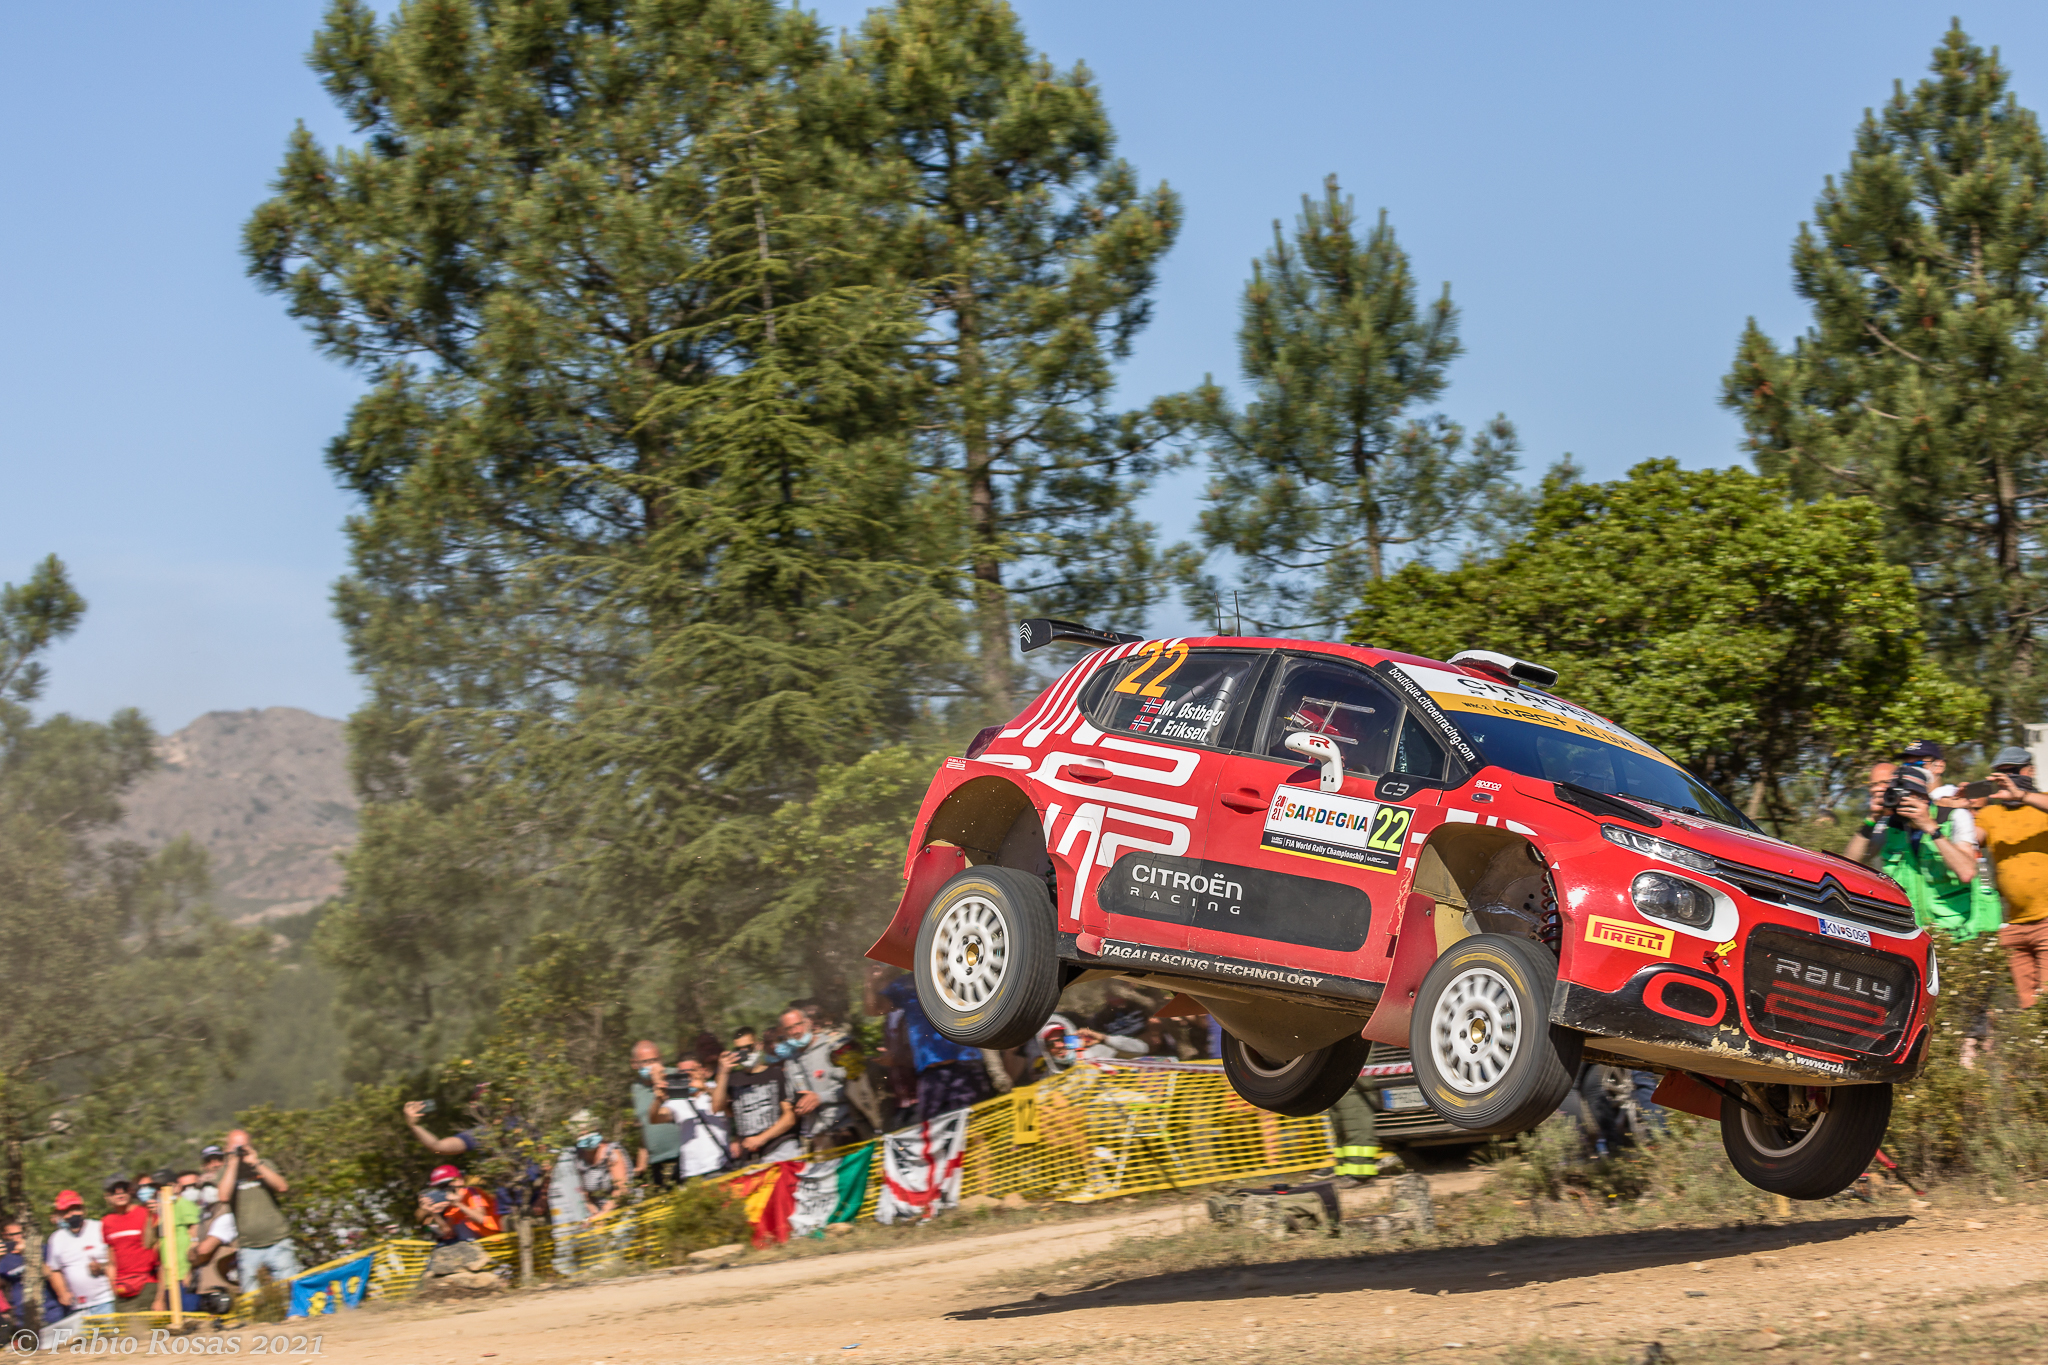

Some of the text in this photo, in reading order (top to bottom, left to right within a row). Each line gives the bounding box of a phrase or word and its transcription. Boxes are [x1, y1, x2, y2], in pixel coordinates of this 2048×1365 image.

[1114, 642, 1189, 698] 22
[1158, 700, 1225, 727] M. Østberg
[1388, 667, 1476, 762] boutique.citroenracing.com
[1149, 718, 1208, 741] T. Eriksen
[1381, 782, 1410, 797] C3
[1285, 803, 1368, 832] SARDEGNA
[1368, 807, 1410, 853] 22
[1285, 839, 1295, 848] FIA
[1296, 841, 1312, 851] World
[1312, 844, 1327, 855] Rally
[1326, 847, 1364, 862] Championship
[1131, 864, 1243, 901] CITROËN
[1130, 886, 1241, 915] RACING
[1592, 921, 1666, 950] PIRELLI
[1826, 922, 1841, 936] KN
[1149, 952, 1209, 970] RACING
[1214, 961, 1324, 988] TECHNOLOGY
